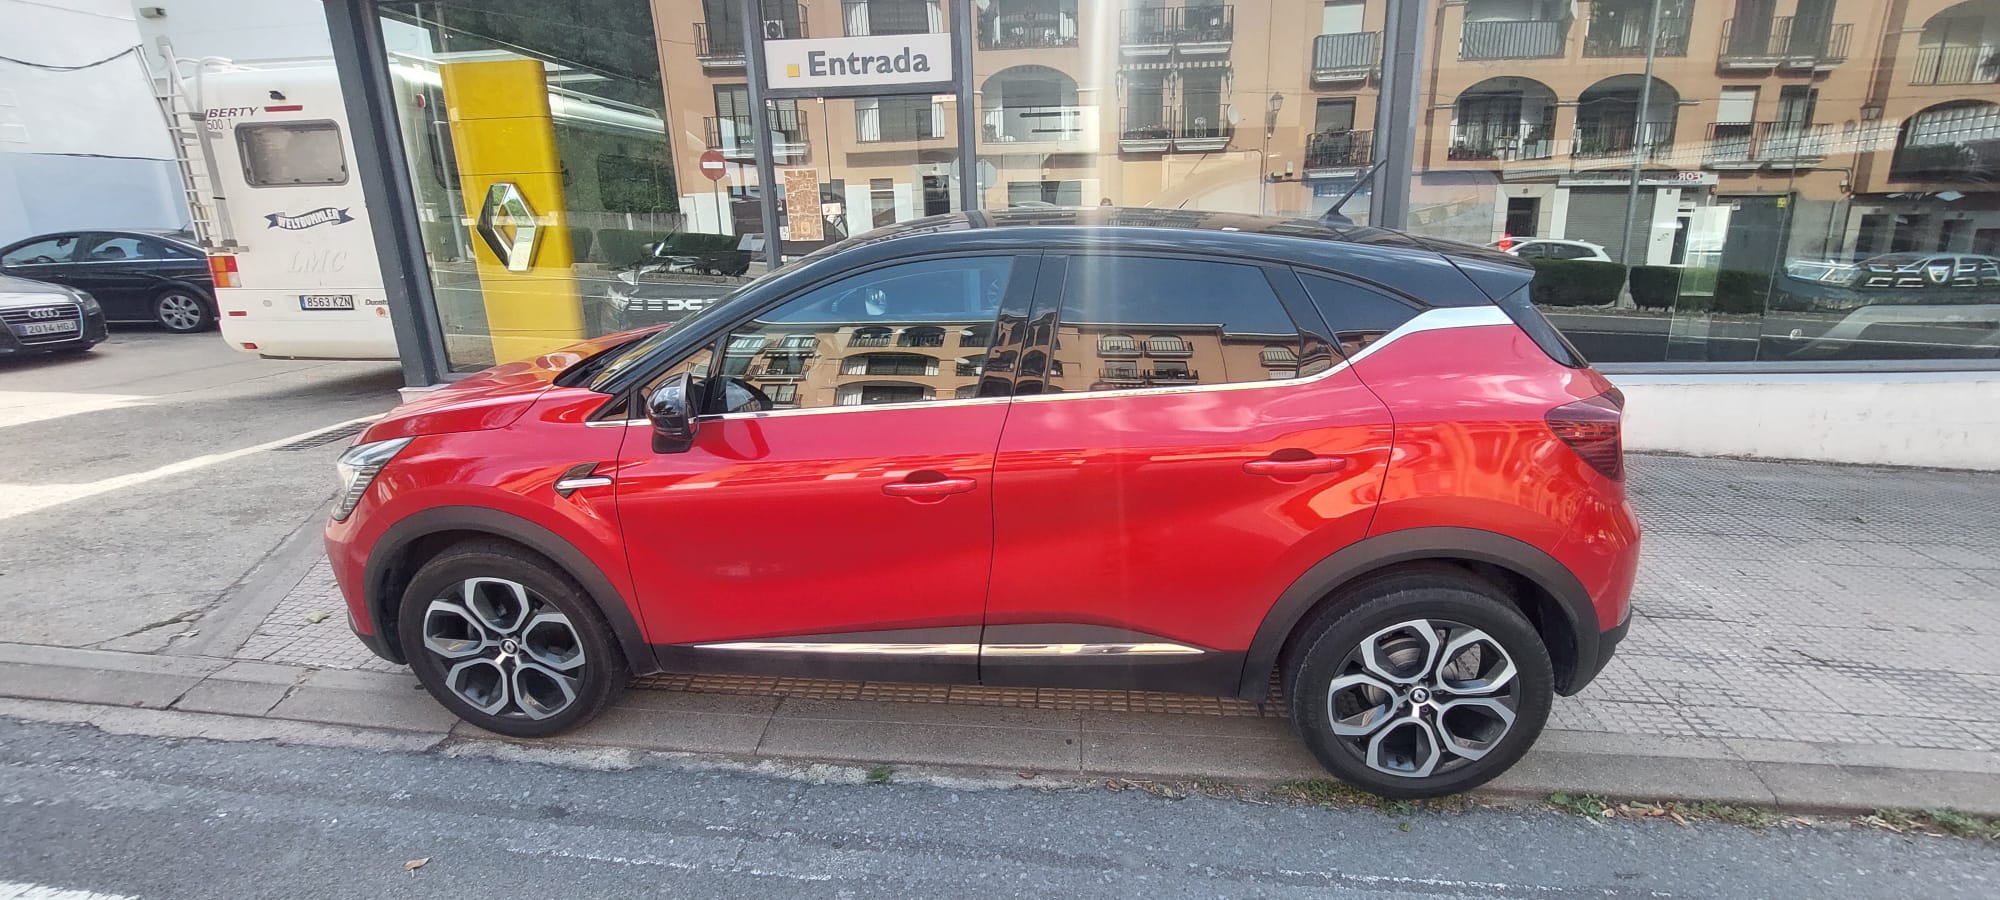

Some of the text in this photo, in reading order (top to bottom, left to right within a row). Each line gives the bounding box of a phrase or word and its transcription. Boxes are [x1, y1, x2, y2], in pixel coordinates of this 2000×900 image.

[807, 46, 930, 77] Entrada
[205, 106, 258, 118] IBERTY
[288, 249, 347, 273] LMC
[307, 297, 352, 307] 8563 KZN
[365, 298, 389, 306] Ducat
[28, 323, 55, 334] 2014
